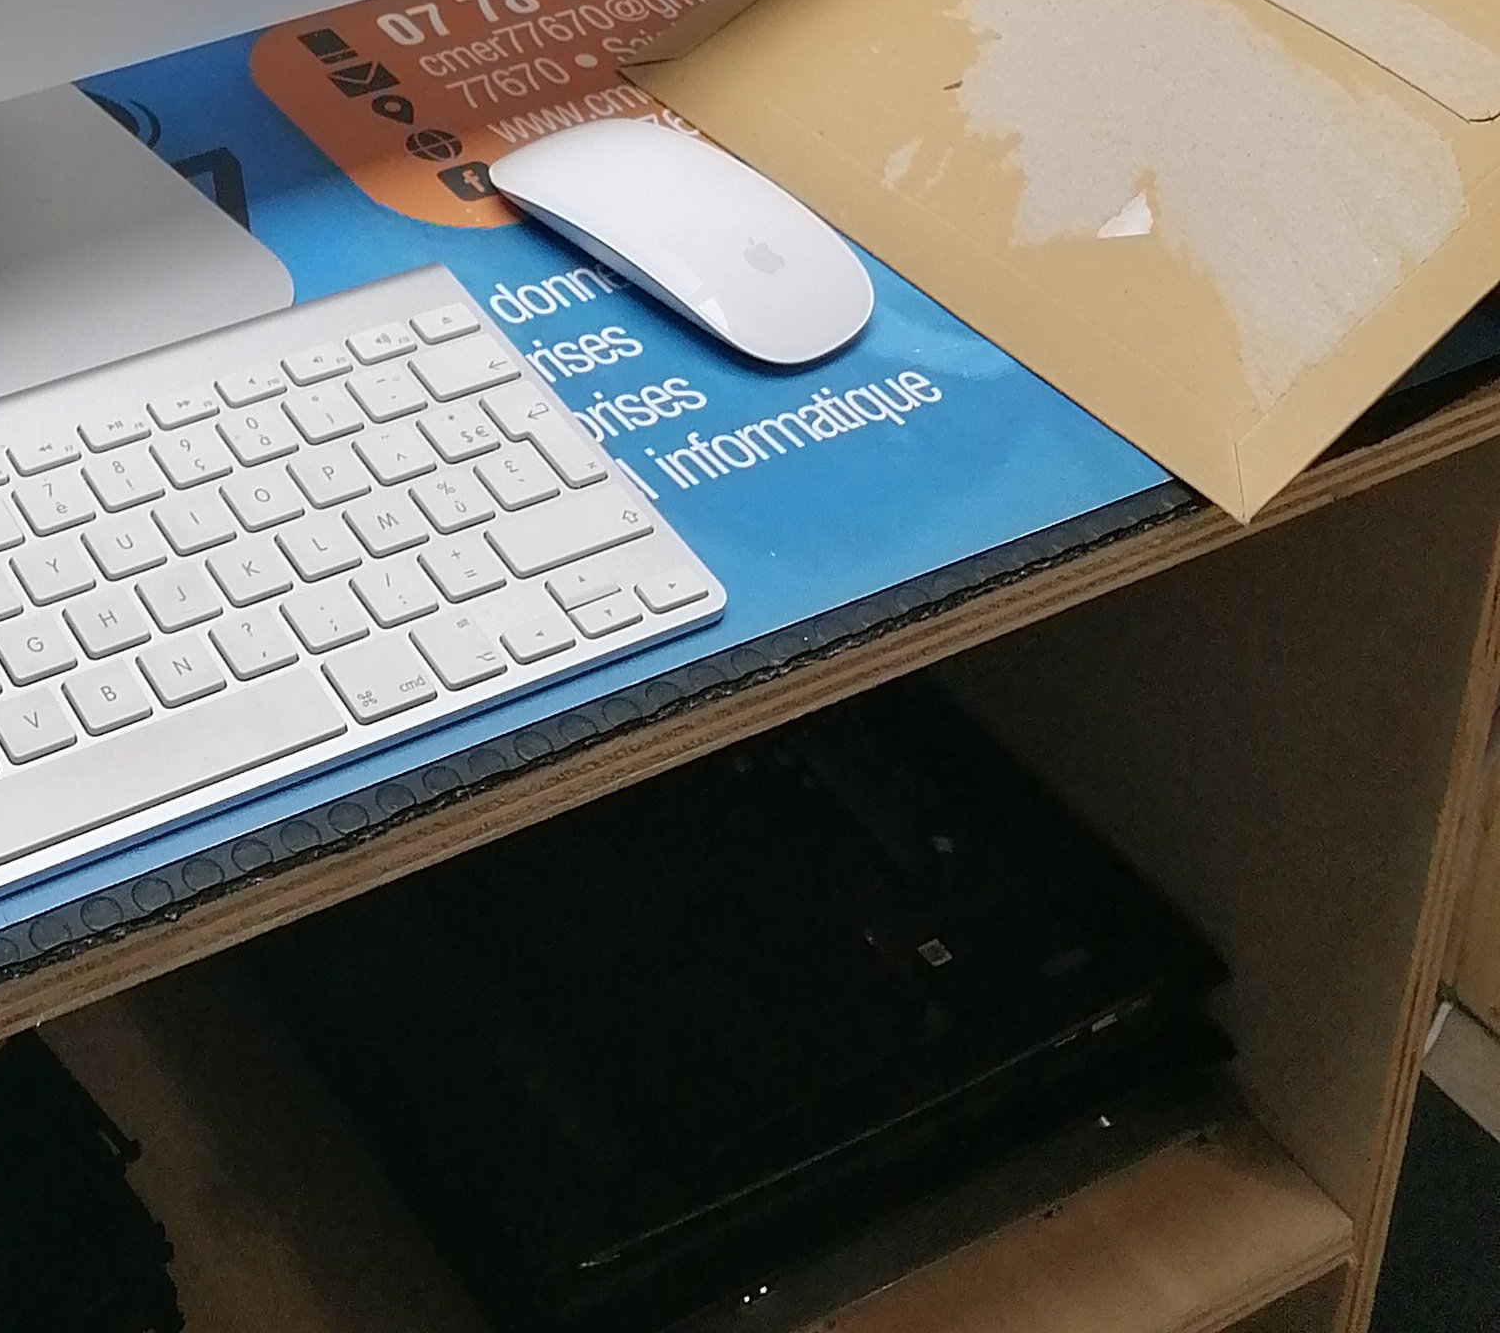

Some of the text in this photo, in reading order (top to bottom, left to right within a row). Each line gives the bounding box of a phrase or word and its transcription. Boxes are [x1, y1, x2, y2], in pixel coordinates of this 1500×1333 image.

[376, 3, 446, 47] 07
[445, 56, 570, 110] 77670
[647, 370, 944, 491] informatique
[398, 675, 426, 693] cmd
